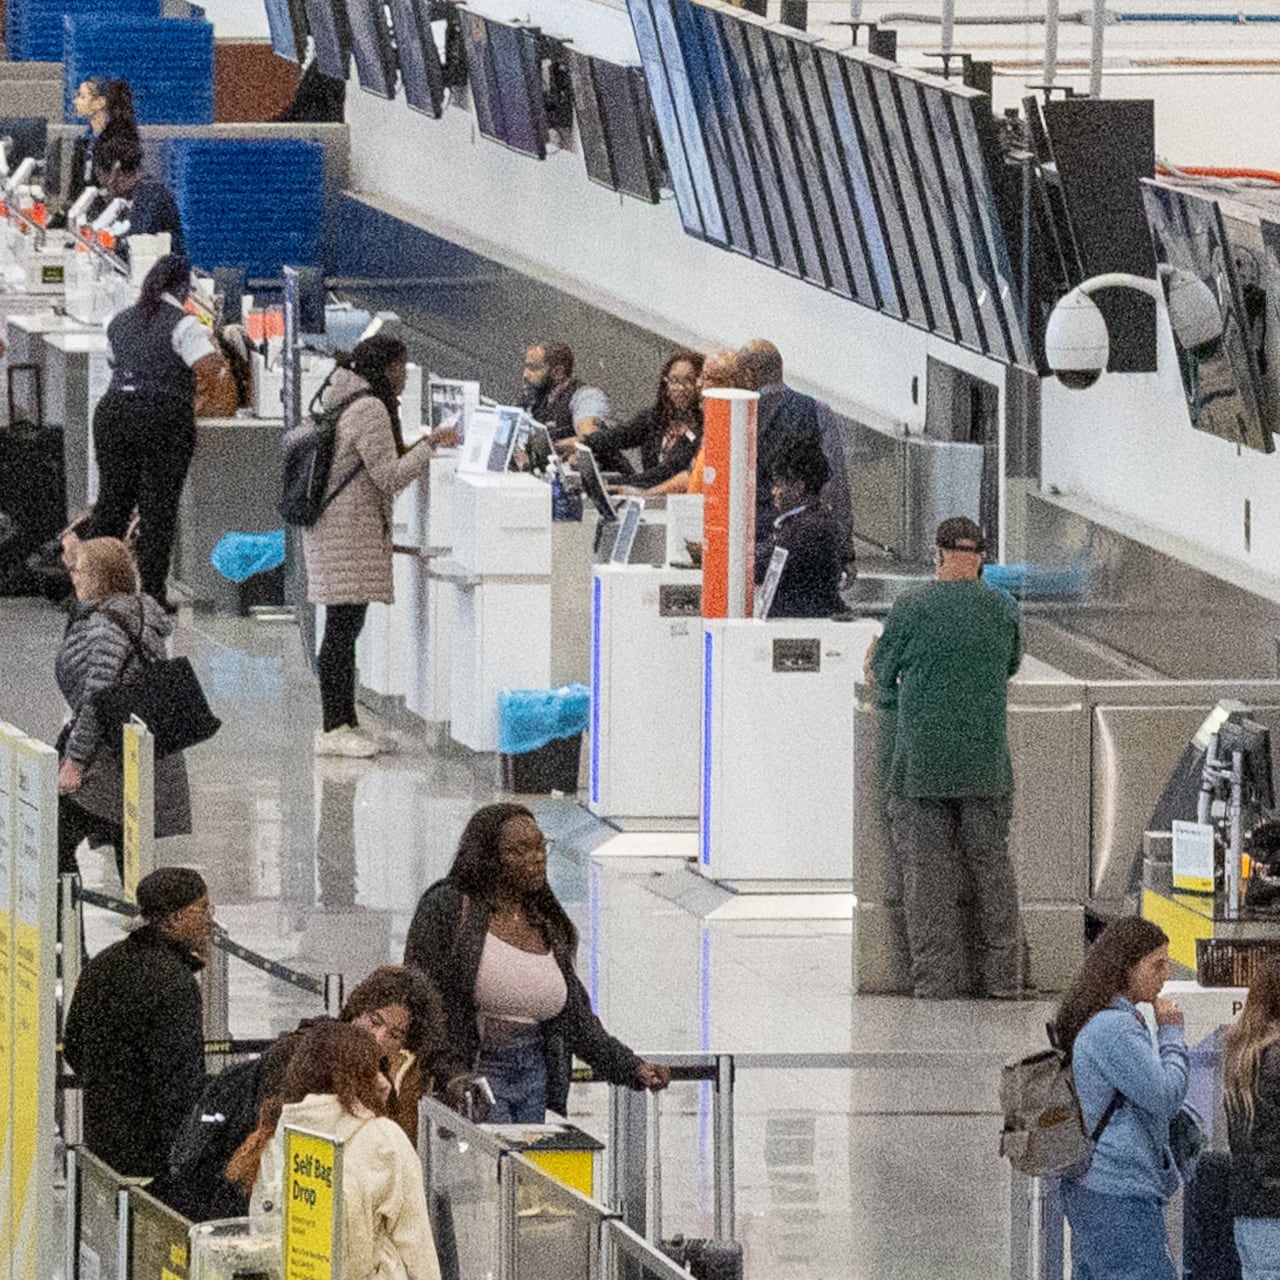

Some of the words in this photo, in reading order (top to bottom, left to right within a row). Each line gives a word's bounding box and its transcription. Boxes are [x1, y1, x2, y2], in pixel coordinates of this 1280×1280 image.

[293, 1152, 313, 1177] Self
[313, 1159, 332, 1189] Bag
[293, 1180, 317, 1208] Drop
